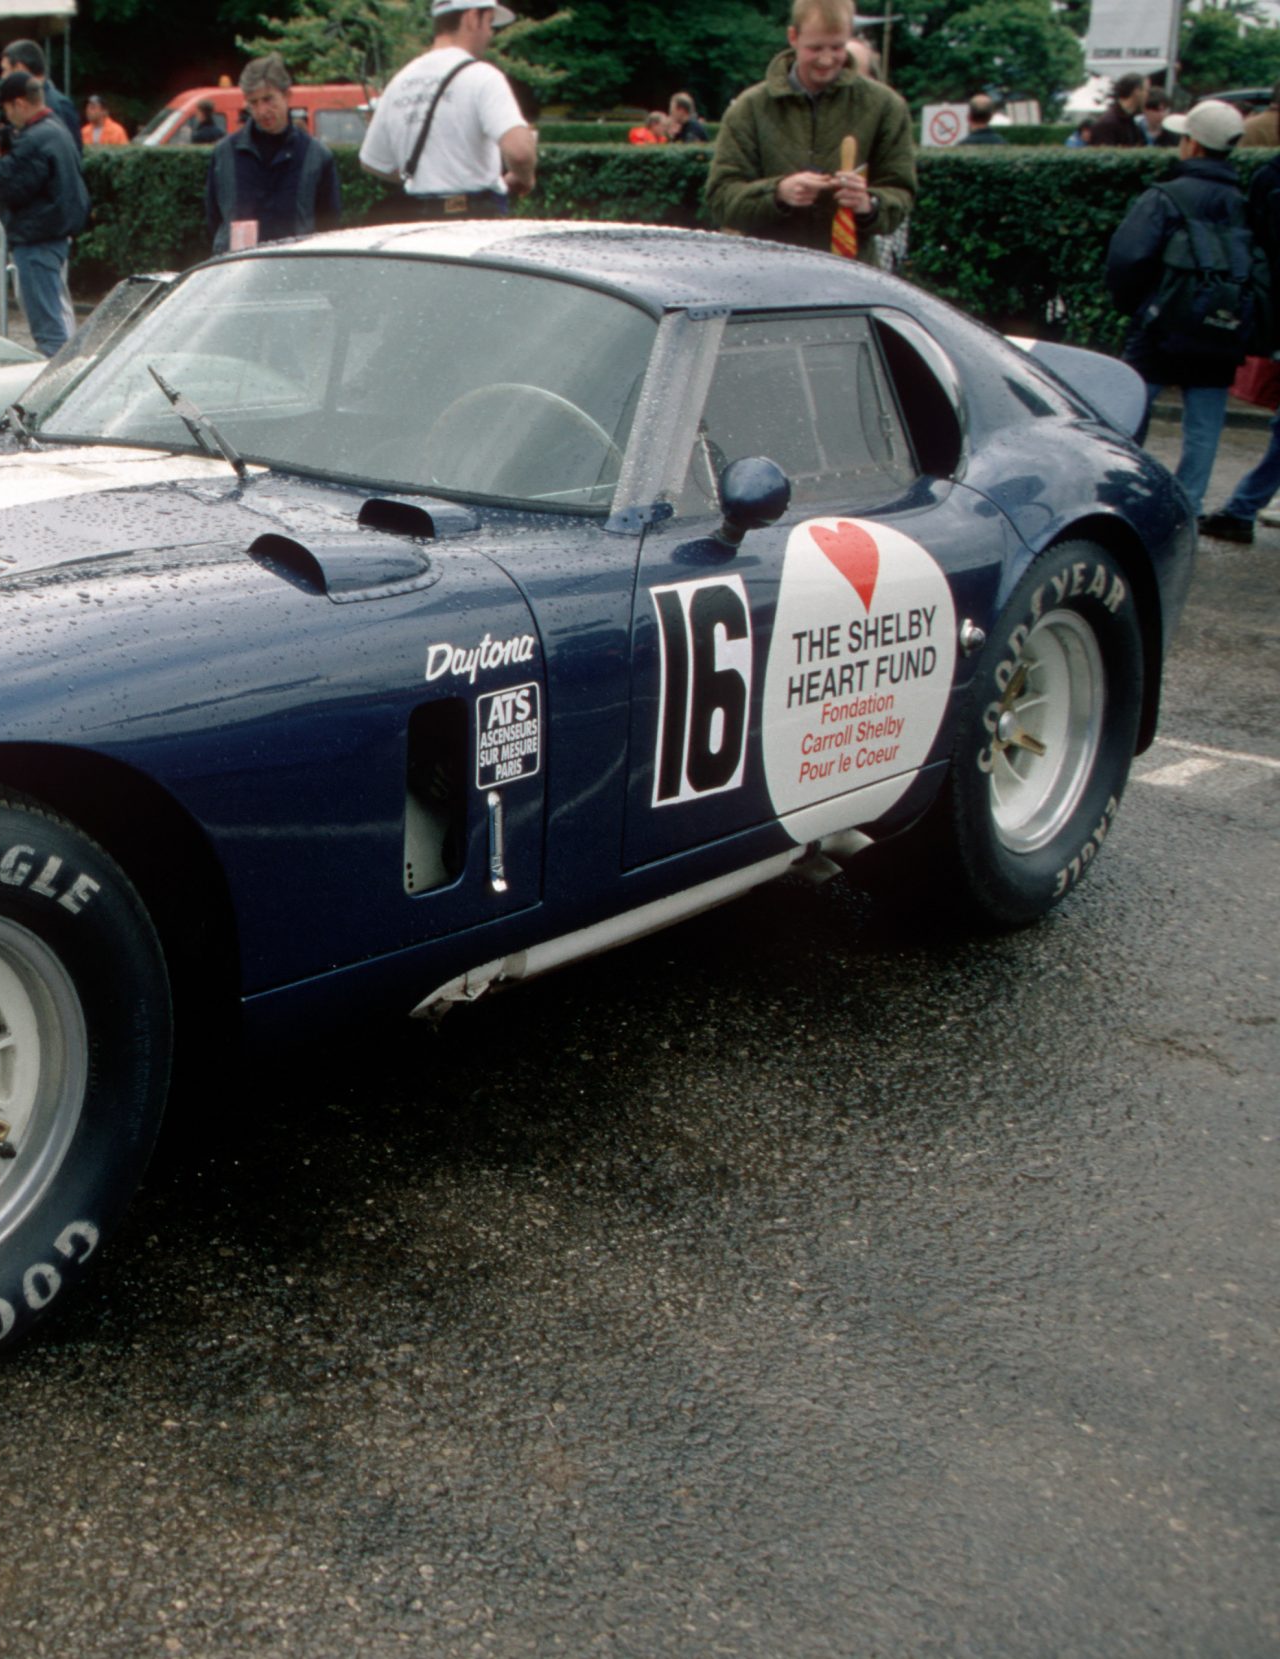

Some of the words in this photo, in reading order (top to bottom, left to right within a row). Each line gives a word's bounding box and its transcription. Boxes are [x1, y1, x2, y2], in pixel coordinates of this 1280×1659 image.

[792, 624, 841, 665] THE
[847, 604, 937, 654] SHELBY
[424, 632, 536, 685] Daytona
[786, 659, 870, 709] HEART
[874, 645, 937, 688] FUND
[487, 689, 531, 729] ATS
[654, 584, 749, 803] 16
[820, 693, 895, 725] Fondation
[478, 746, 500, 769] SUR
[500, 735, 538, 764] MESURE
[480, 718, 538, 749] ASCENSEURS
[801, 724, 854, 756] Carroll
[855, 715, 905, 744] Shelby
[494, 757, 524, 781] PARIS
[798, 760, 836, 784] Pour
[838, 752, 852, 774] le
[855, 744, 900, 770] Coeur
